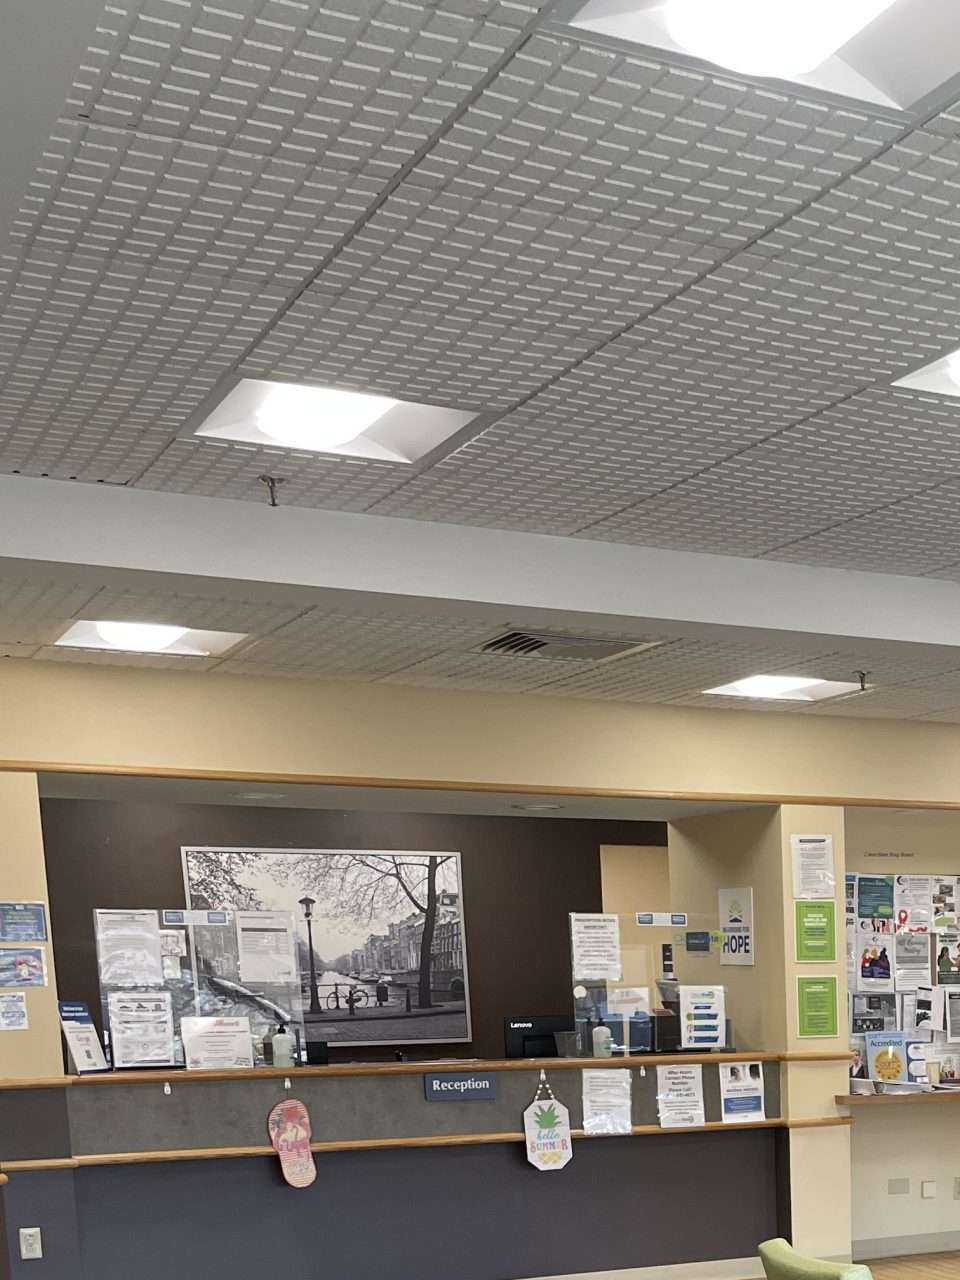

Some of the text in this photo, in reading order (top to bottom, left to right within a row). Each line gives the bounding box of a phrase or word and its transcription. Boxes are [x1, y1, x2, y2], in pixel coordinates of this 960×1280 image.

[722, 935, 750, 954] HOPE
[871, 1039, 903, 1047] Accredited
[432, 1078, 490, 1093] Reception
[537, 1129, 560, 1141] hello
